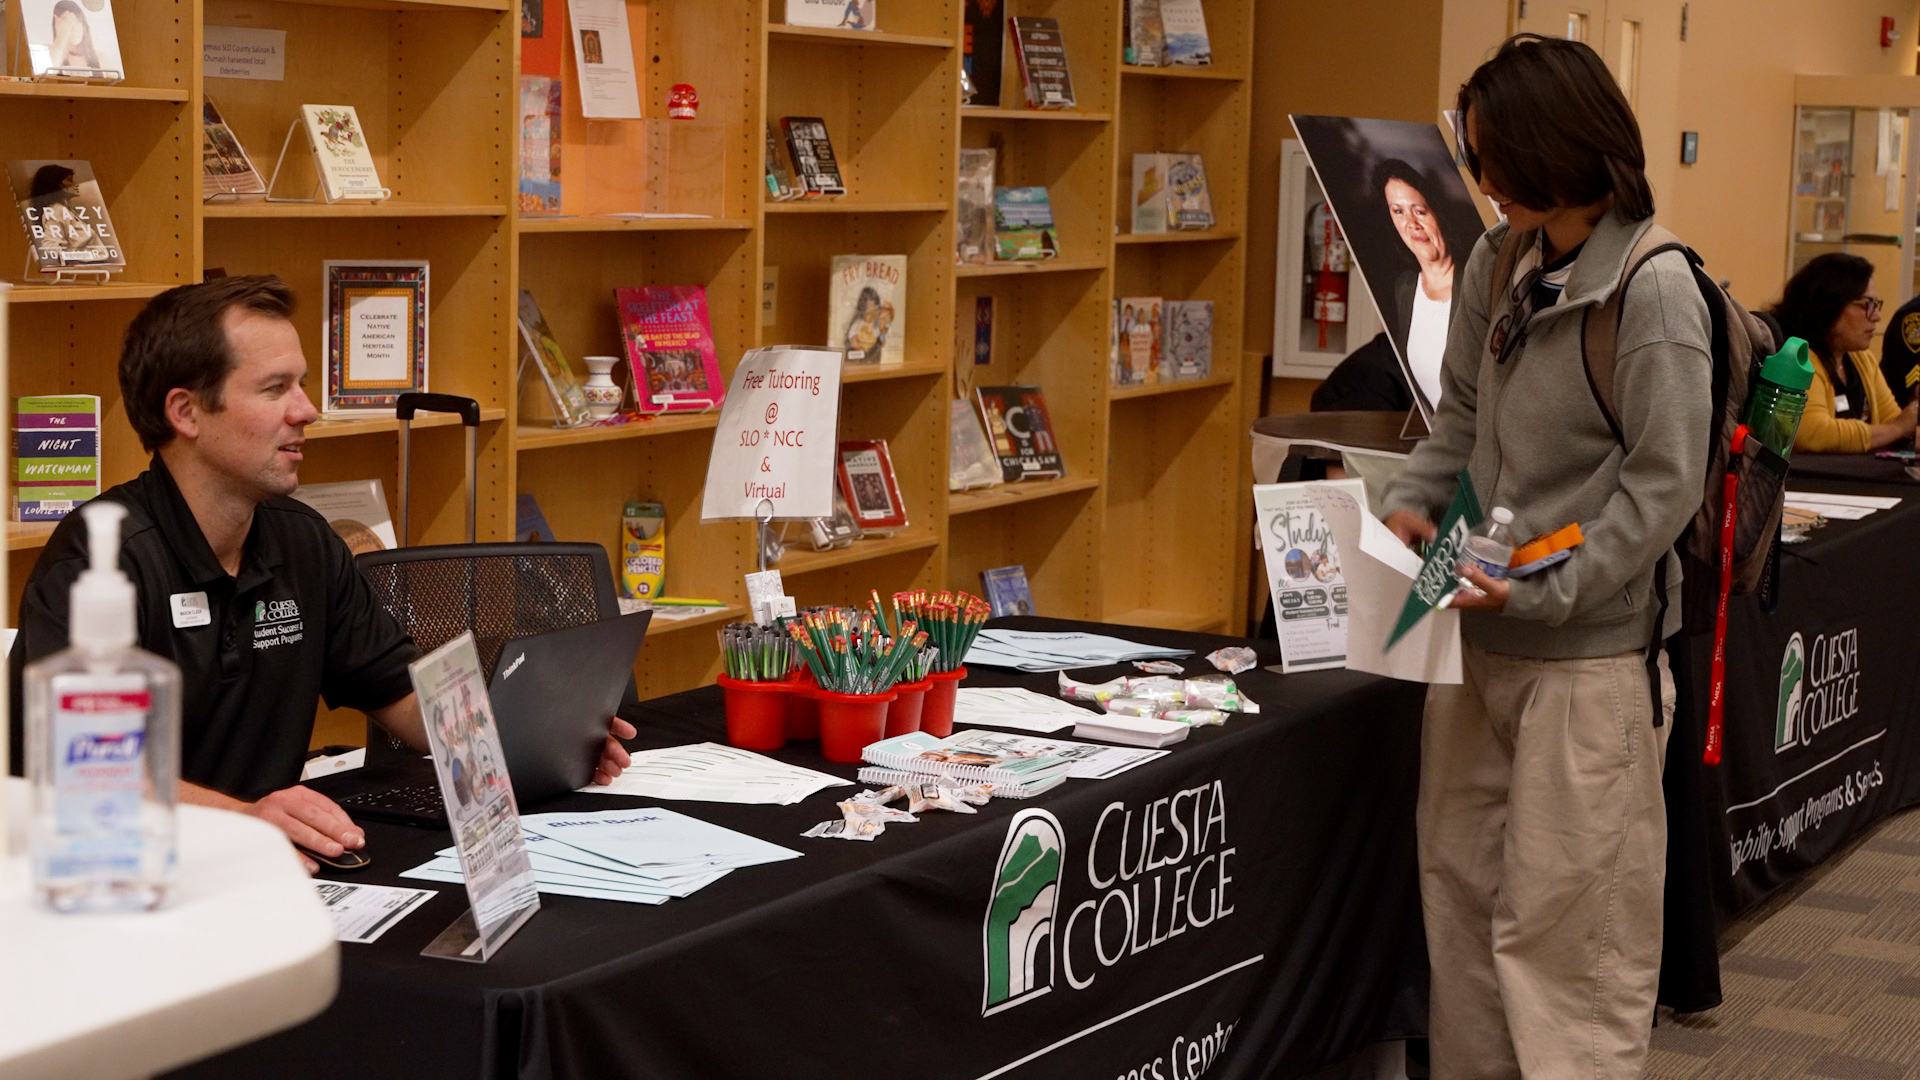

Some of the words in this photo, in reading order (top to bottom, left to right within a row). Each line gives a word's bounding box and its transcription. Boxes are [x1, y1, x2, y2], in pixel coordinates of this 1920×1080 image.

[26, 206, 103, 221] CRAZY
[31, 224, 111, 239] BRAVE
[842, 264, 860, 285] FRY
[866, 261, 900, 285] BREAD
[684, 299, 700, 311] AT
[640, 312, 660, 323] THE
[661, 311, 694, 323] FEAST
[743, 370, 766, 389] Free
[768, 369, 821, 396] Tutoring
[49, 417, 66, 425] THE
[765, 402, 779, 425] @
[1005, 406, 1031, 439] C
[38, 439, 81, 451] NIGHT
[740, 429, 760, 447] SLO
[773, 430, 804, 447] NCC
[25, 464, 91, 475] WATCHMAN
[760, 456, 771, 472] &
[744, 482, 786, 498] Virtual
[625, 556, 664, 567] COLORED
[627, 564, 662, 575] PENCILS
[269, 600, 298, 611] CUESTA
[267, 608, 300, 620] COLLEGE
[254, 626, 278, 638] tudent
[253, 636, 281, 649] Support
[1810, 628, 1858, 687] CUESTA
[1801, 671, 1860, 746] COLLEGE
[547, 820, 600, 828] Blue
[602, 815, 662, 825] Book
[1773, 803, 1805, 853] Support
[1805, 785, 1844, 829] Programs
[1845, 775, 1856, 806] &
[1087, 779, 1228, 890] CUESTA
[1062, 847, 1236, 990] COLLEGE
